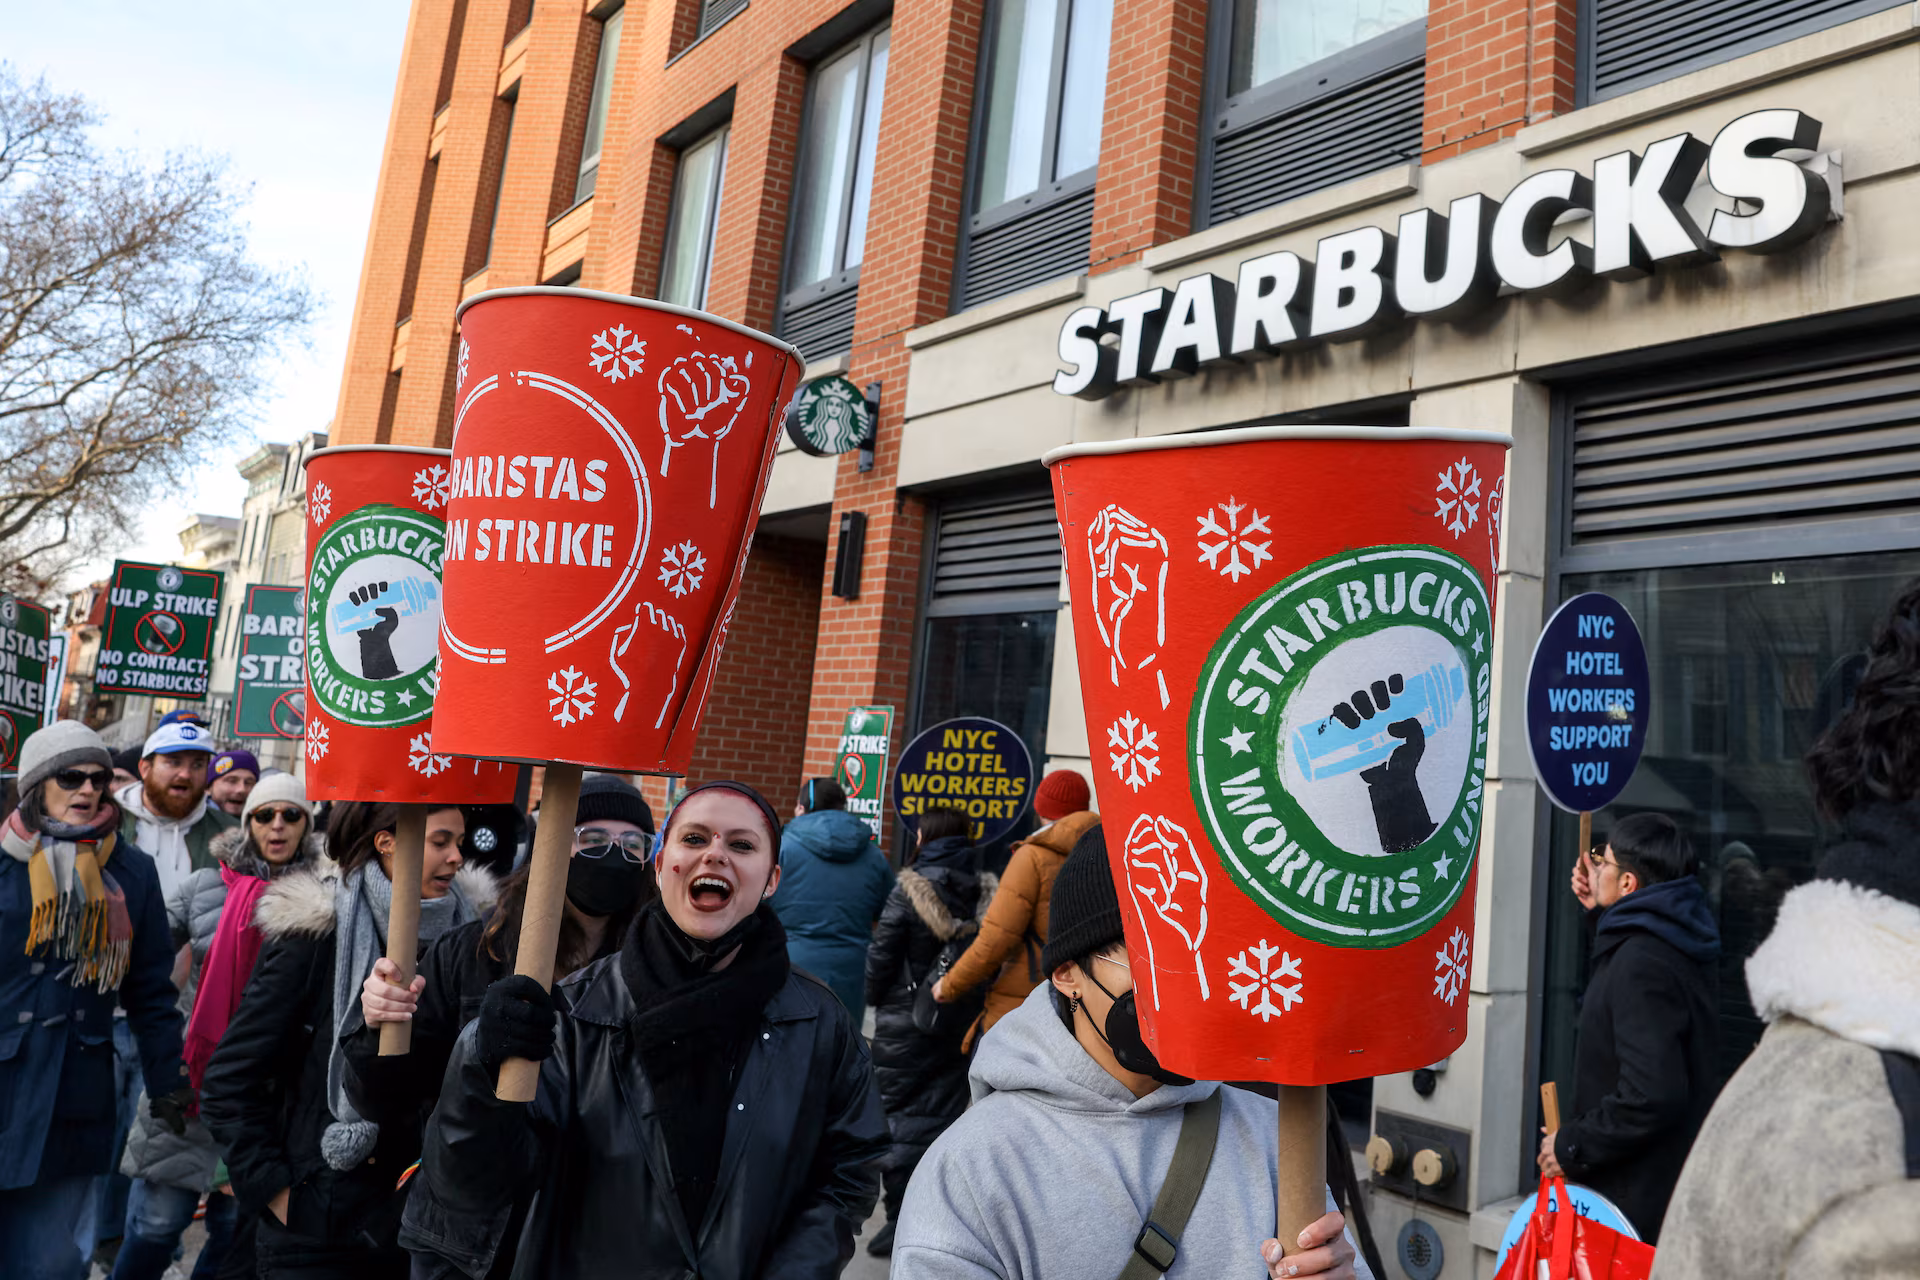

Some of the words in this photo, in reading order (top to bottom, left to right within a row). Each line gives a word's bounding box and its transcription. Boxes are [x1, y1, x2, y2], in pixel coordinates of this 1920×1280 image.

[1051, 106, 1822, 401] STARBUCKS
[450, 455, 609, 502] BARISTAS
[444, 518, 469, 561] ON
[475, 518, 615, 568] STRIKE
[313, 525, 445, 593] STARBUCKS
[110, 587, 149, 608] ULP
[153, 592, 219, 617] STRIKE
[243, 613, 304, 637] BARI
[1578, 614, 1615, 640] NYC
[0, 625, 49, 663] ISTAS
[287, 637, 304, 656] O
[1227, 571, 1476, 716] STARBUCKS
[99, 649, 123, 665] NO
[127, 651, 209, 677] CONTRACT,
[238, 653, 304, 681] STR
[308, 620, 386, 715] WORKERS
[1566, 651, 1624, 676] HOTEL
[0, 672, 45, 712] IKE!
[95, 667, 118, 684] NO
[121, 670, 208, 693] STARBUCKS!
[1548, 688, 1635, 713] WORKERS
[846, 735, 888, 754] STRIKE
[943, 728, 998, 750] NYC
[1550, 725, 1633, 750] SUPPORT
[925, 751, 1007, 774] HOTEL
[1452, 662, 1490, 848] UNITED
[900, 773, 1026, 796] WORKERS
[1571, 761, 1609, 786] YOU
[846, 797, 879, 816] TRACT,
[1220, 767, 1421, 915] WORKERS
